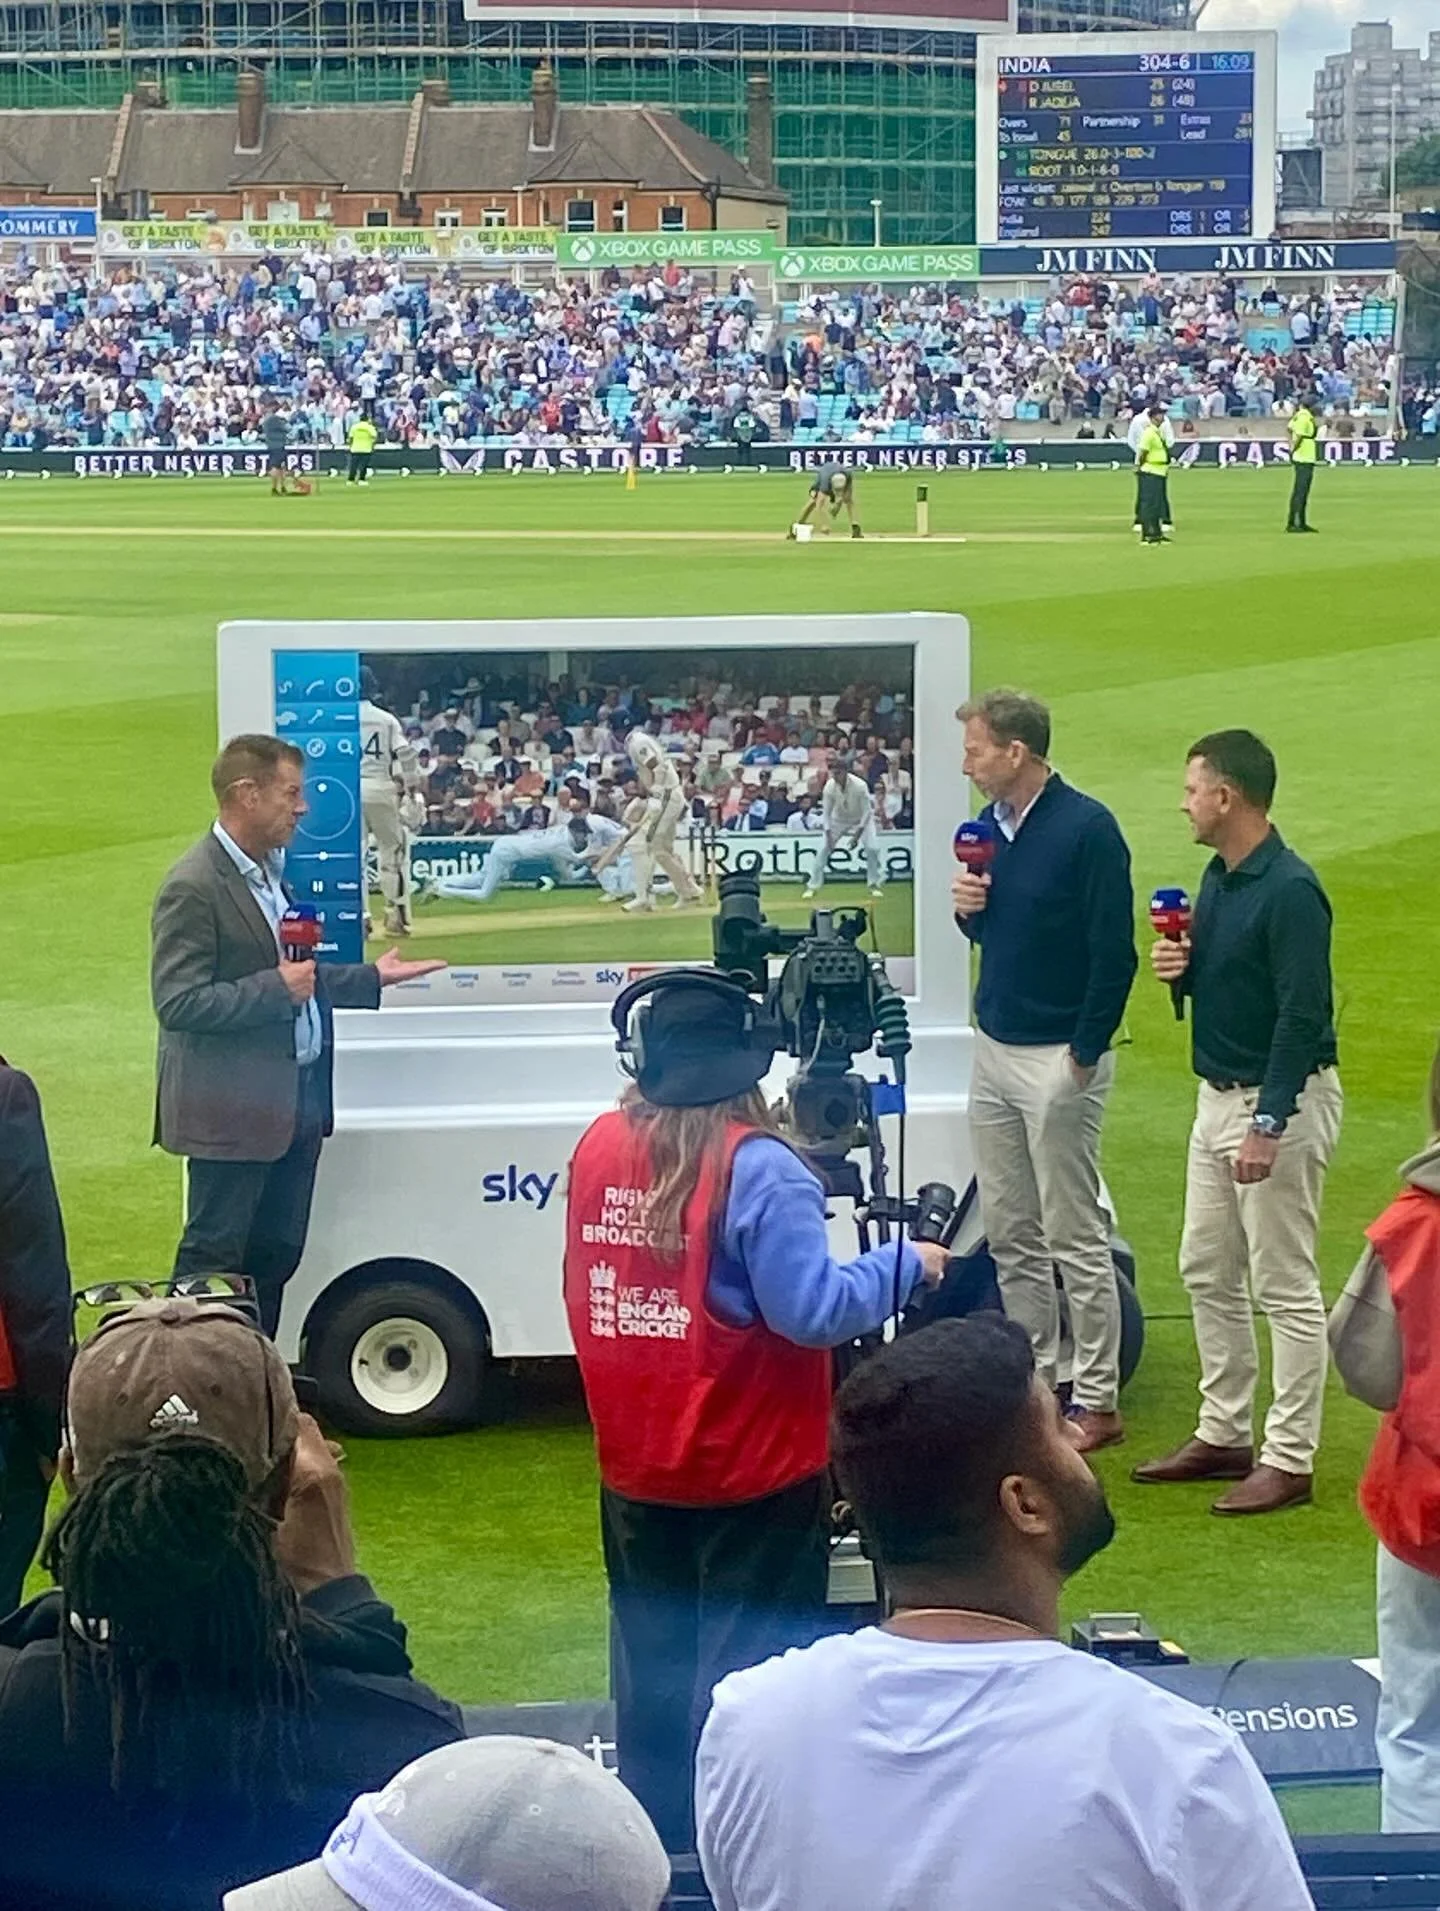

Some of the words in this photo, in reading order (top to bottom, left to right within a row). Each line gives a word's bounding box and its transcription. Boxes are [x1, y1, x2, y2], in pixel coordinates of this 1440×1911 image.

[999, 58, 1051, 73] INDIA
[1139, 55, 1190, 71] 304-6
[1082, 115, 1141, 128] Partnership
[1181, 129, 1206, 140] Lead
[0, 219, 78, 235] OMMERY
[122, 225, 144, 237] GET
[148, 225, 156, 236] A
[158, 225, 193, 237] TASTE
[249, 225, 269, 237] GET
[272, 225, 281, 236] A
[286, 225, 318, 236] TASTE
[355, 231, 377, 242] GET
[378, 231, 387, 242] A
[390, 231, 424, 242] TASTE
[478, 231, 499, 242] GET
[502, 231, 510, 242] A
[513, 231, 547, 242] TASTE
[600, 239, 650, 257] XBOX
[653, 239, 708, 257] GAME
[713, 239, 761, 256] PASS
[1215, 246, 1256, 269] JM
[1264, 245, 1336, 268] FINN
[809, 255, 861, 273] XBOX
[863, 255, 919, 272] GAME
[924, 254, 974, 271] PASS
[1036, 249, 1077, 271] JM
[1086, 248, 1156, 272] FINN
[789, 450, 868, 467] BETTER
[879, 449, 947, 466] NEVER
[958, 449, 1027, 466] STPS
[1218, 441, 1396, 463] CASORE
[75, 455, 153, 472] BETTER
[165, 455, 234, 471] NEVER
[245, 454, 313, 470] STPS
[596, 968, 624, 985] sky
[483, 1164, 558, 1210] sky
[618, 1286, 644, 1302] WE
[648, 1287, 680, 1304] ARE
[617, 1302, 691, 1324] ENGLAND
[617, 1320, 687, 1340] CRICKET
